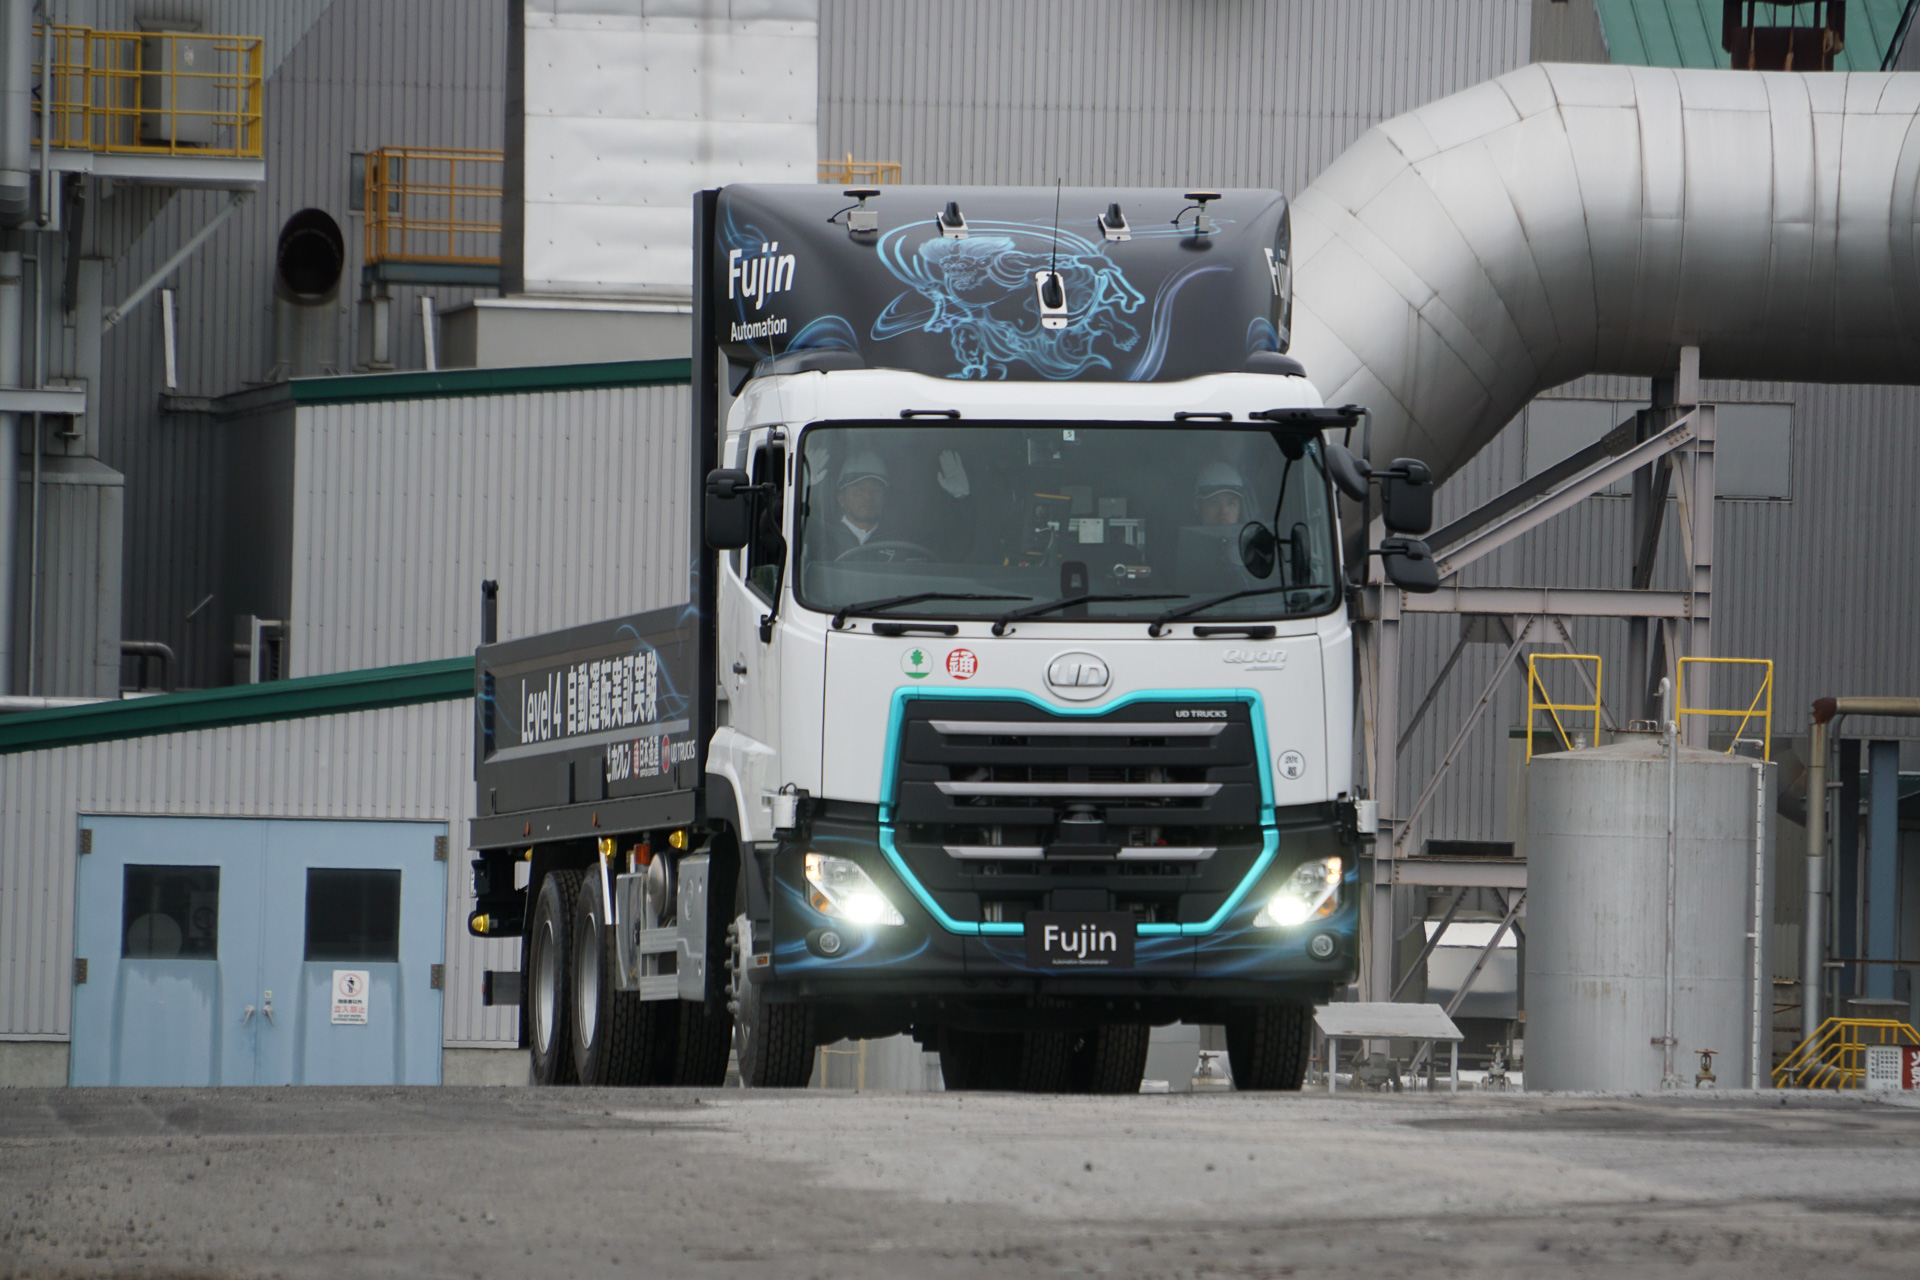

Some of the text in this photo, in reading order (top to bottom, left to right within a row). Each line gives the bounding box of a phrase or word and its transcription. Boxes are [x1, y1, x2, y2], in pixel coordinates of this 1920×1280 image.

[728, 241, 796, 310] Fujin
[730, 314, 788, 342] Automation
[948, 650, 976, 677] 通
[521, 671, 562, 744] Level 4
[567, 649, 658, 736] 自動運転実証実験
[1175, 710, 1228, 718] UD TRUCKS
[1044, 924, 1117, 959] Fujin
